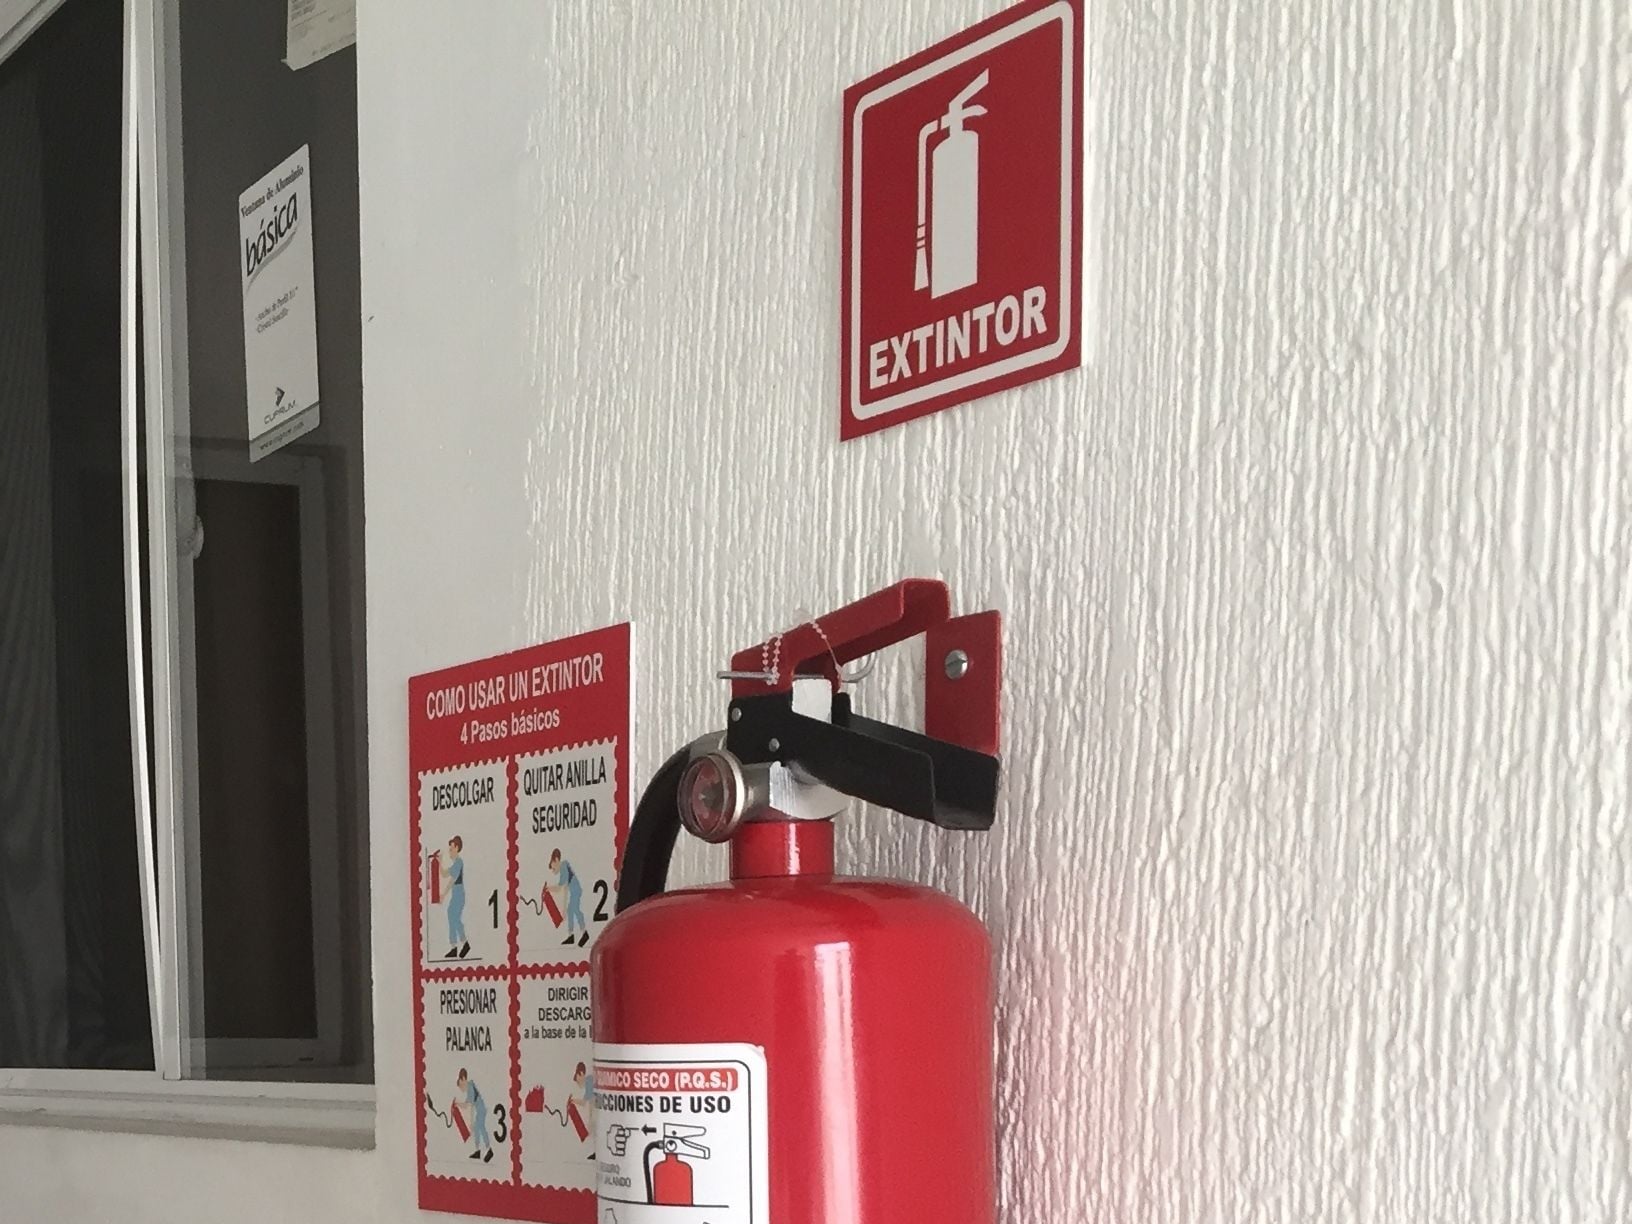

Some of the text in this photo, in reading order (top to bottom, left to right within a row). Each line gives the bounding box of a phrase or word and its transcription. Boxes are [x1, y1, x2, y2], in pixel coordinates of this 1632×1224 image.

[246, 192, 298, 277] básica
[869, 286, 1047, 390] EXTINTOR
[426, 652, 604, 720] COMO USAR UN EXTINTOR
[460, 707, 560, 745] 4 Pasos básicos
[433, 776, 495, 811] DESCOLGAR
[524, 756, 607, 797] QUITAR ANILLA
[532, 798, 598, 834] SEGURIDAD
[488, 889, 499, 930] 1
[593, 879, 609, 923] 2
[440, 988, 497, 1015] PRESIONAR
[548, 986, 588, 1001] DIRIGIR
[524, 1028, 530, 1039] a
[532, 1025, 539, 1039] la
[541, 1025, 563, 1039] base
[565, 1024, 576, 1039] de
[579, 1024, 587, 1039] la
[538, 1006, 592, 1021] DESCARG
[446, 1026, 492, 1052] PALANCA
[633, 1071, 670, 1089] SECO
[659, 1095, 683, 1113] DE
[690, 1095, 732, 1114] USO
[493, 1104, 507, 1143] 3
